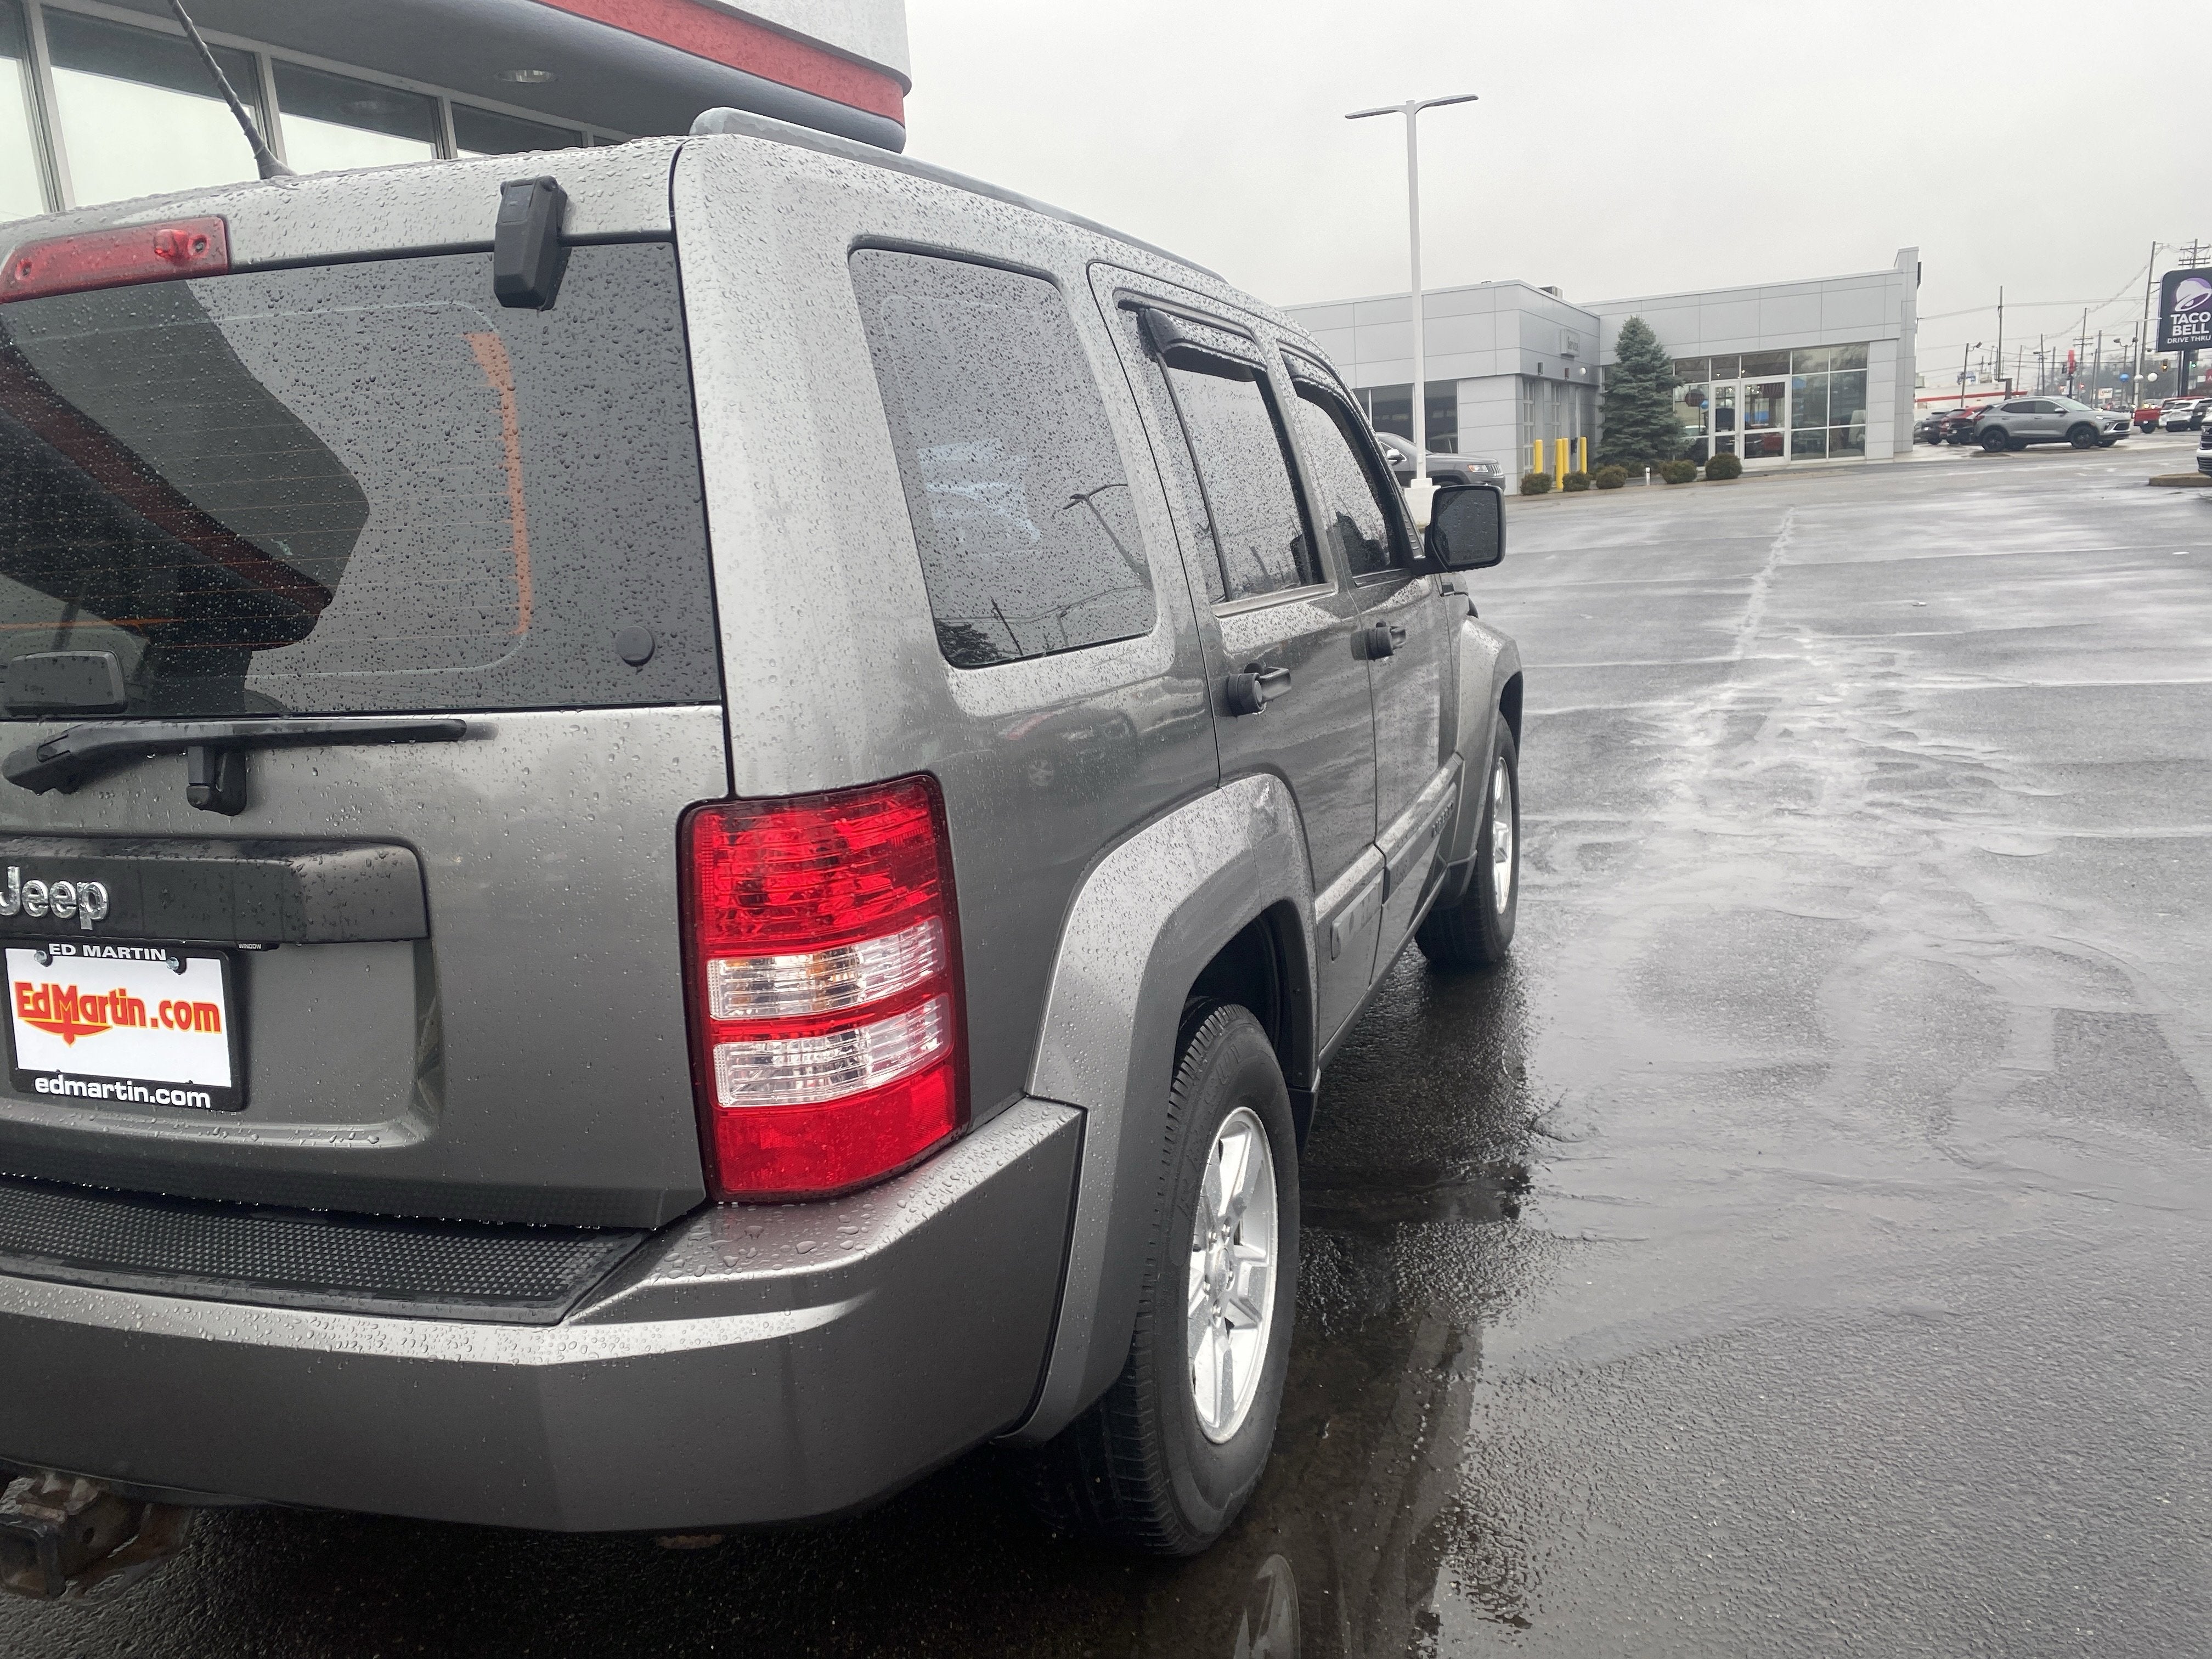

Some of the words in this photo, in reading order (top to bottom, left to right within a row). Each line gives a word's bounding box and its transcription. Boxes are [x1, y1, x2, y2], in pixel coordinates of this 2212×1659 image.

[2170, 312, 2211, 325] TACO
[2172, 324, 2210, 336] BELL
[0, 866, 108, 930] Jeep
[49, 943, 76, 956] ED
[83, 945, 166, 961] MARTIN
[14, 981, 222, 1034] EdMartin.com
[35, 1074, 211, 1108] edmartin.com
